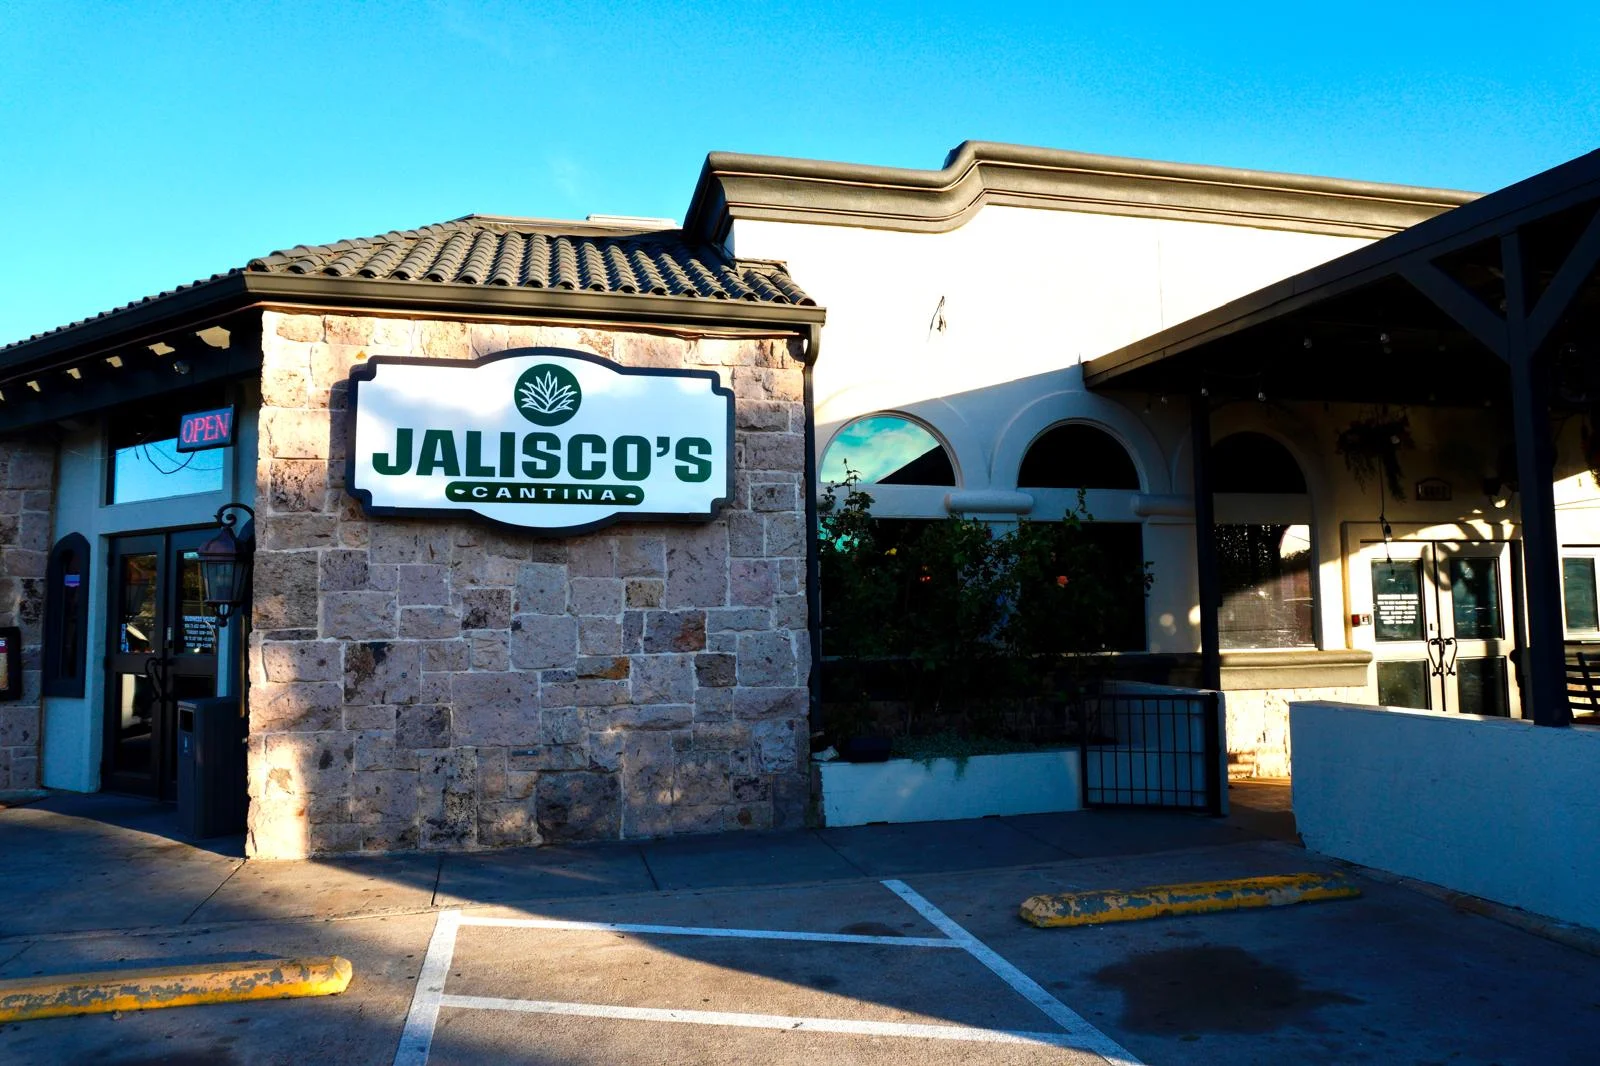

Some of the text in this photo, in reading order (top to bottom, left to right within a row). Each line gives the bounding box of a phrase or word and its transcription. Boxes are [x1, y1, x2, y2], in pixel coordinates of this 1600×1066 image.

[182, 412, 231, 443] OPEN
[372, 427, 712, 483] JALISCO'S
[471, 486, 617, 501] CANTINA
